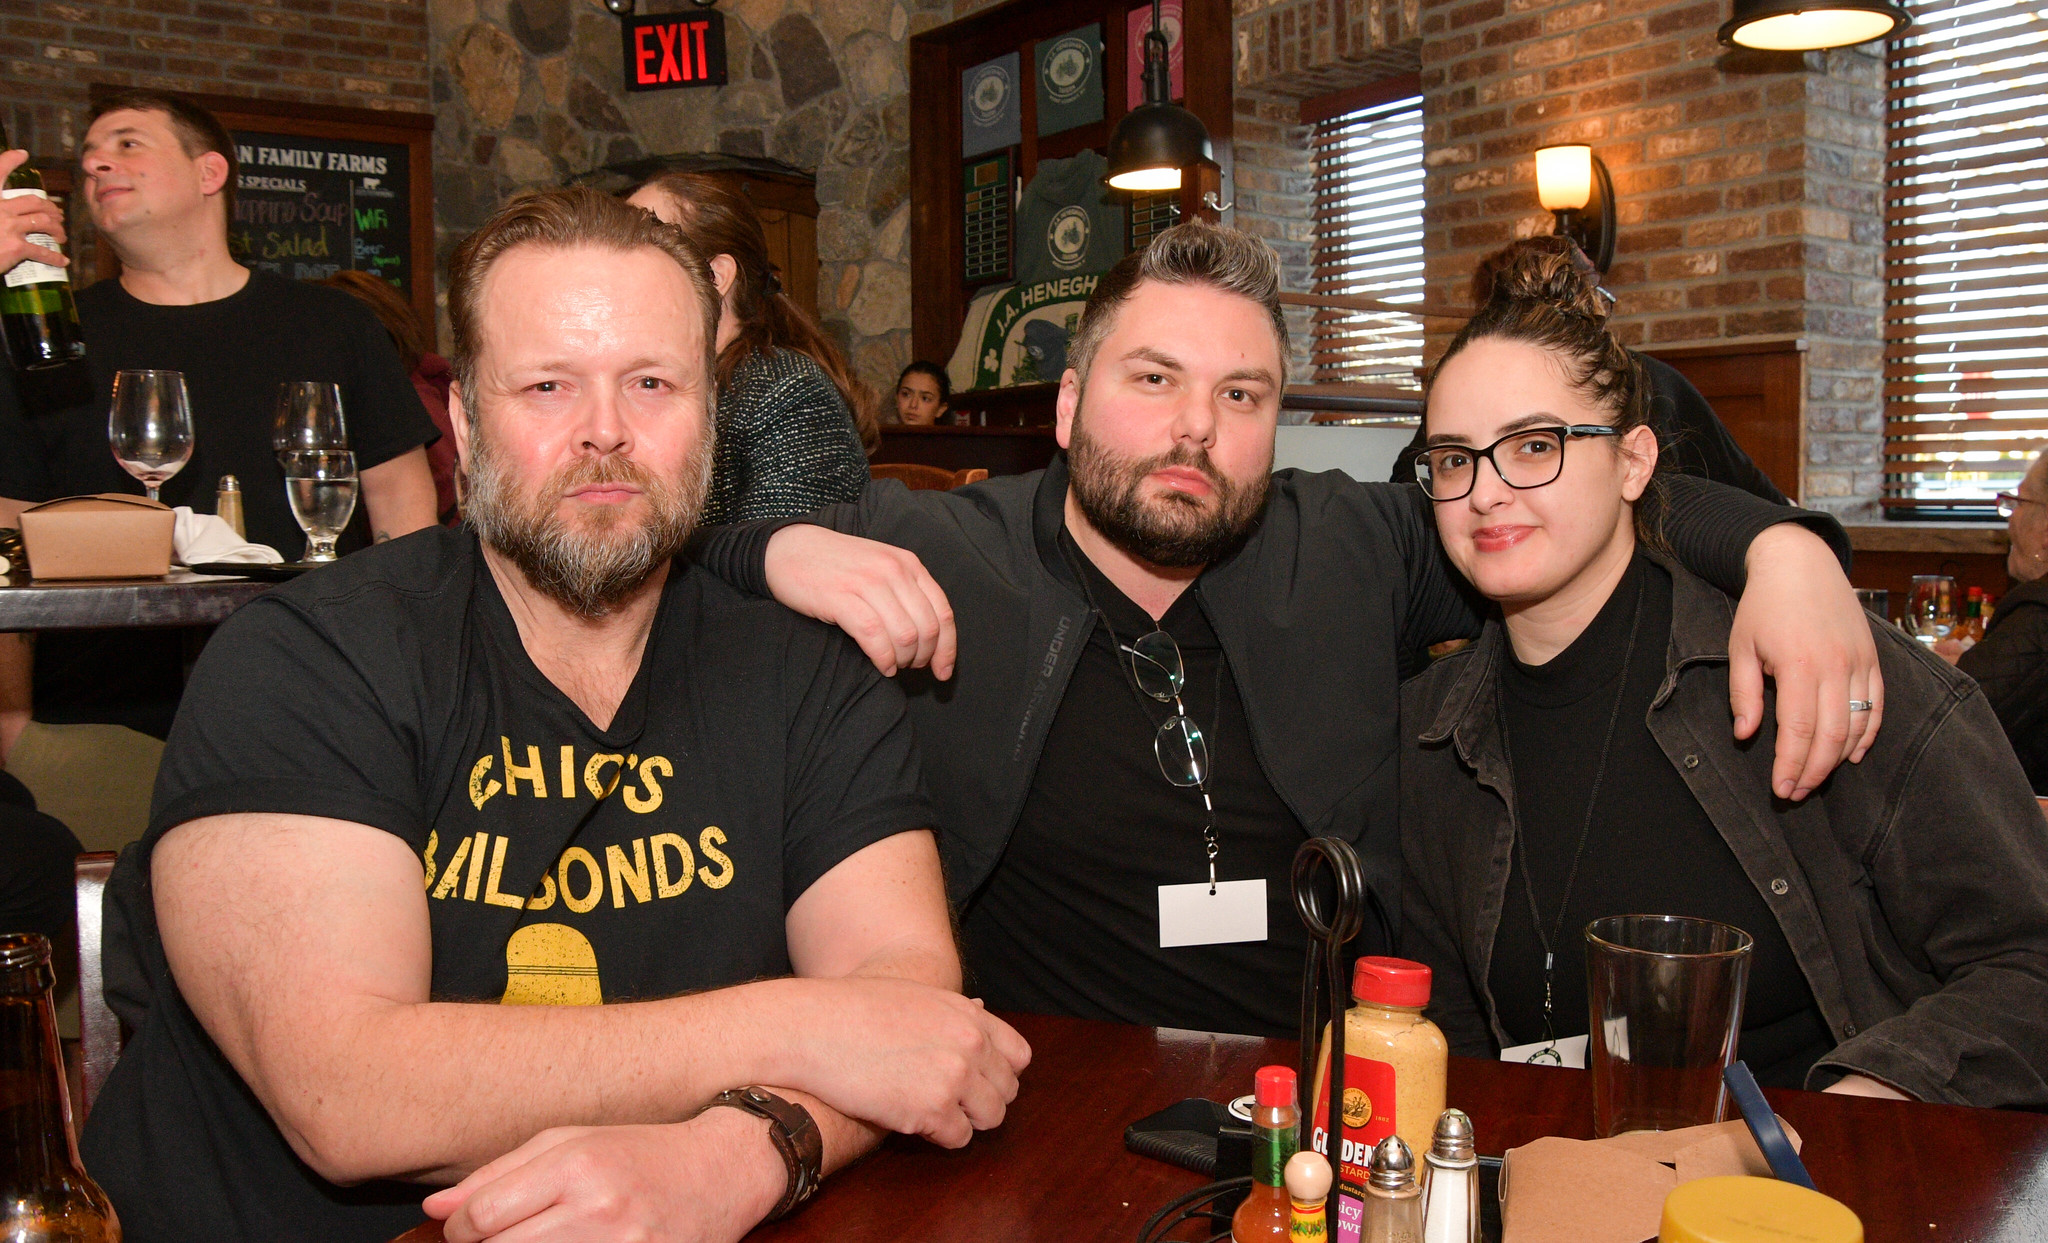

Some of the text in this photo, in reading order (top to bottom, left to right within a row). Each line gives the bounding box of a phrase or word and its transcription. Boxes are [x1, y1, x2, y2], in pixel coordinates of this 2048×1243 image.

[635, 21, 709, 84] EXIT
[258, 147, 323, 169] FAMILY
[327, 153, 388, 175] FARMS
[245, 175, 307, 191] SPECIALS
[262, 225, 329, 259] Salad
[1021, 275, 1099, 309] HENEGH
[1041, 614, 1072, 678] UNDER
[1338, 1201, 1361, 1220] icy
